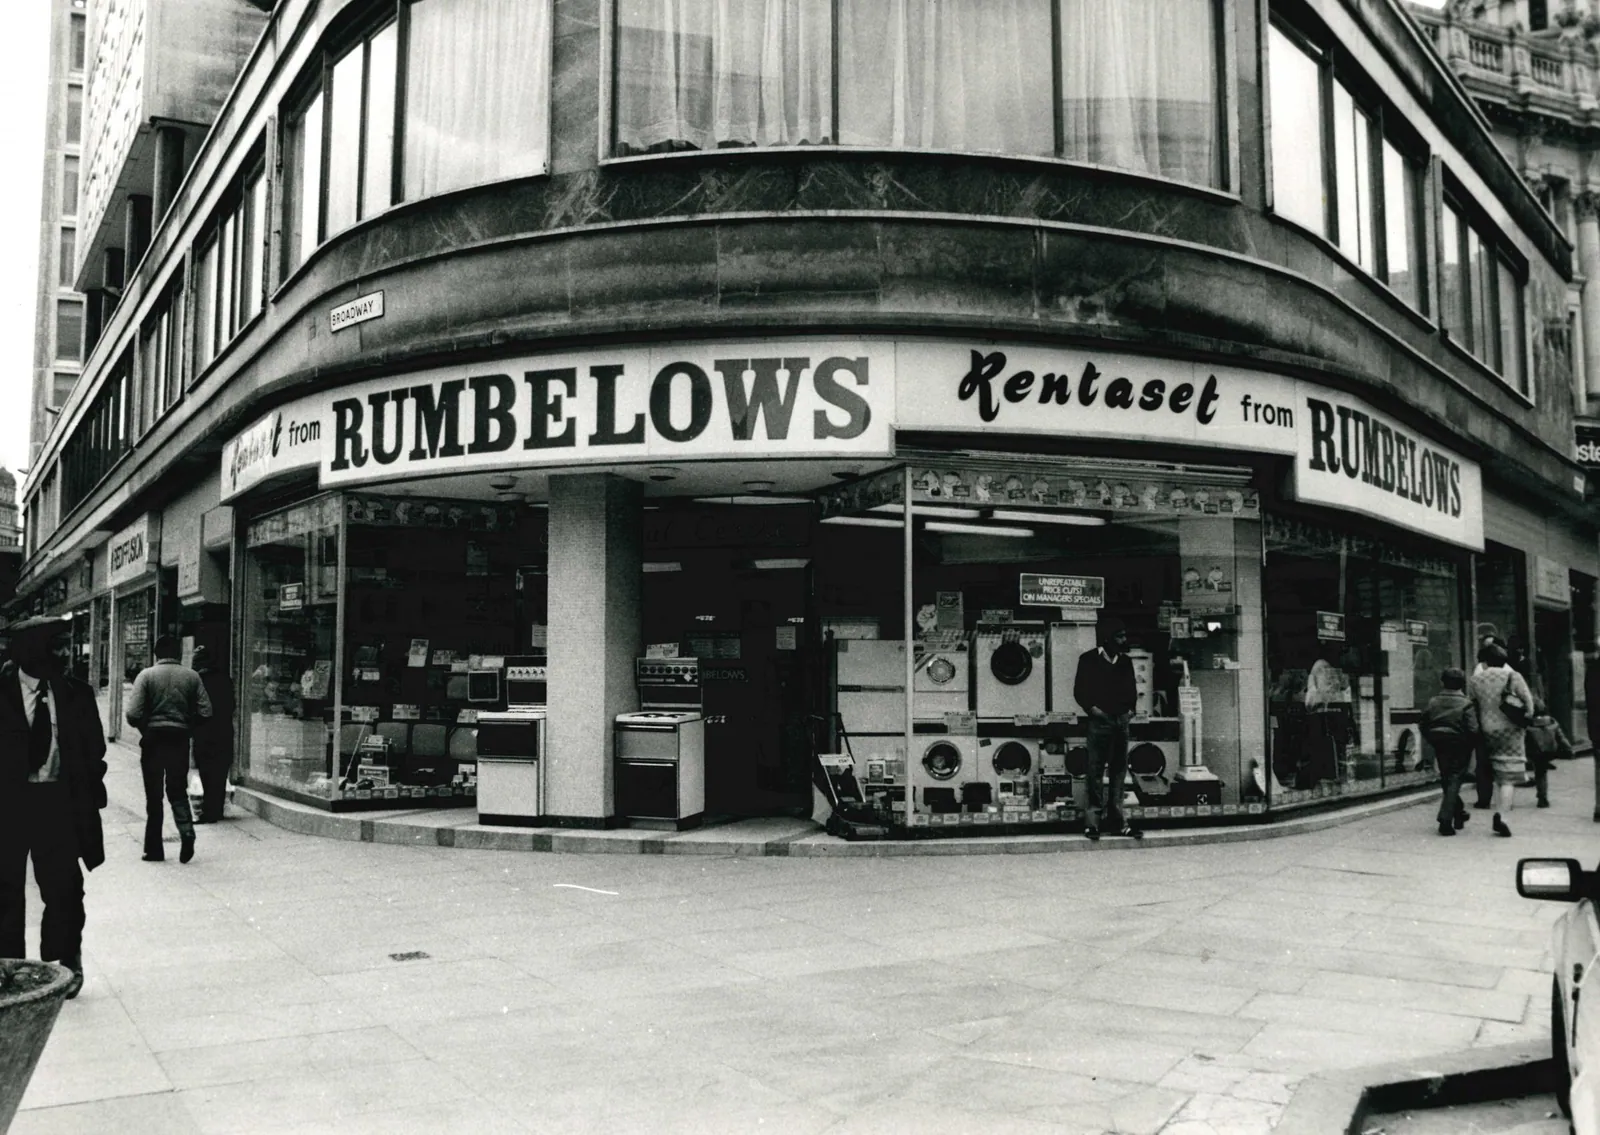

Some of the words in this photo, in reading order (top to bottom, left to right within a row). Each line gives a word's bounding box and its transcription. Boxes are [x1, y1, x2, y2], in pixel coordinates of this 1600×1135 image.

[332, 300, 373, 326] BROADWAY
[958, 349, 1219, 425] Rentaset
[1240, 394, 1294, 428] from
[331, 356, 872, 472] RUMBELOWS
[289, 419, 321, 447] from
[1306, 397, 1462, 519] RUMBELOWS
[1038, 578, 1086, 587] UNREPEATABLE
[1043, 586, 1061, 594] PRICE
[1023, 593, 1034, 601] ON
[1073, 595, 1101, 604] SPECIALS
